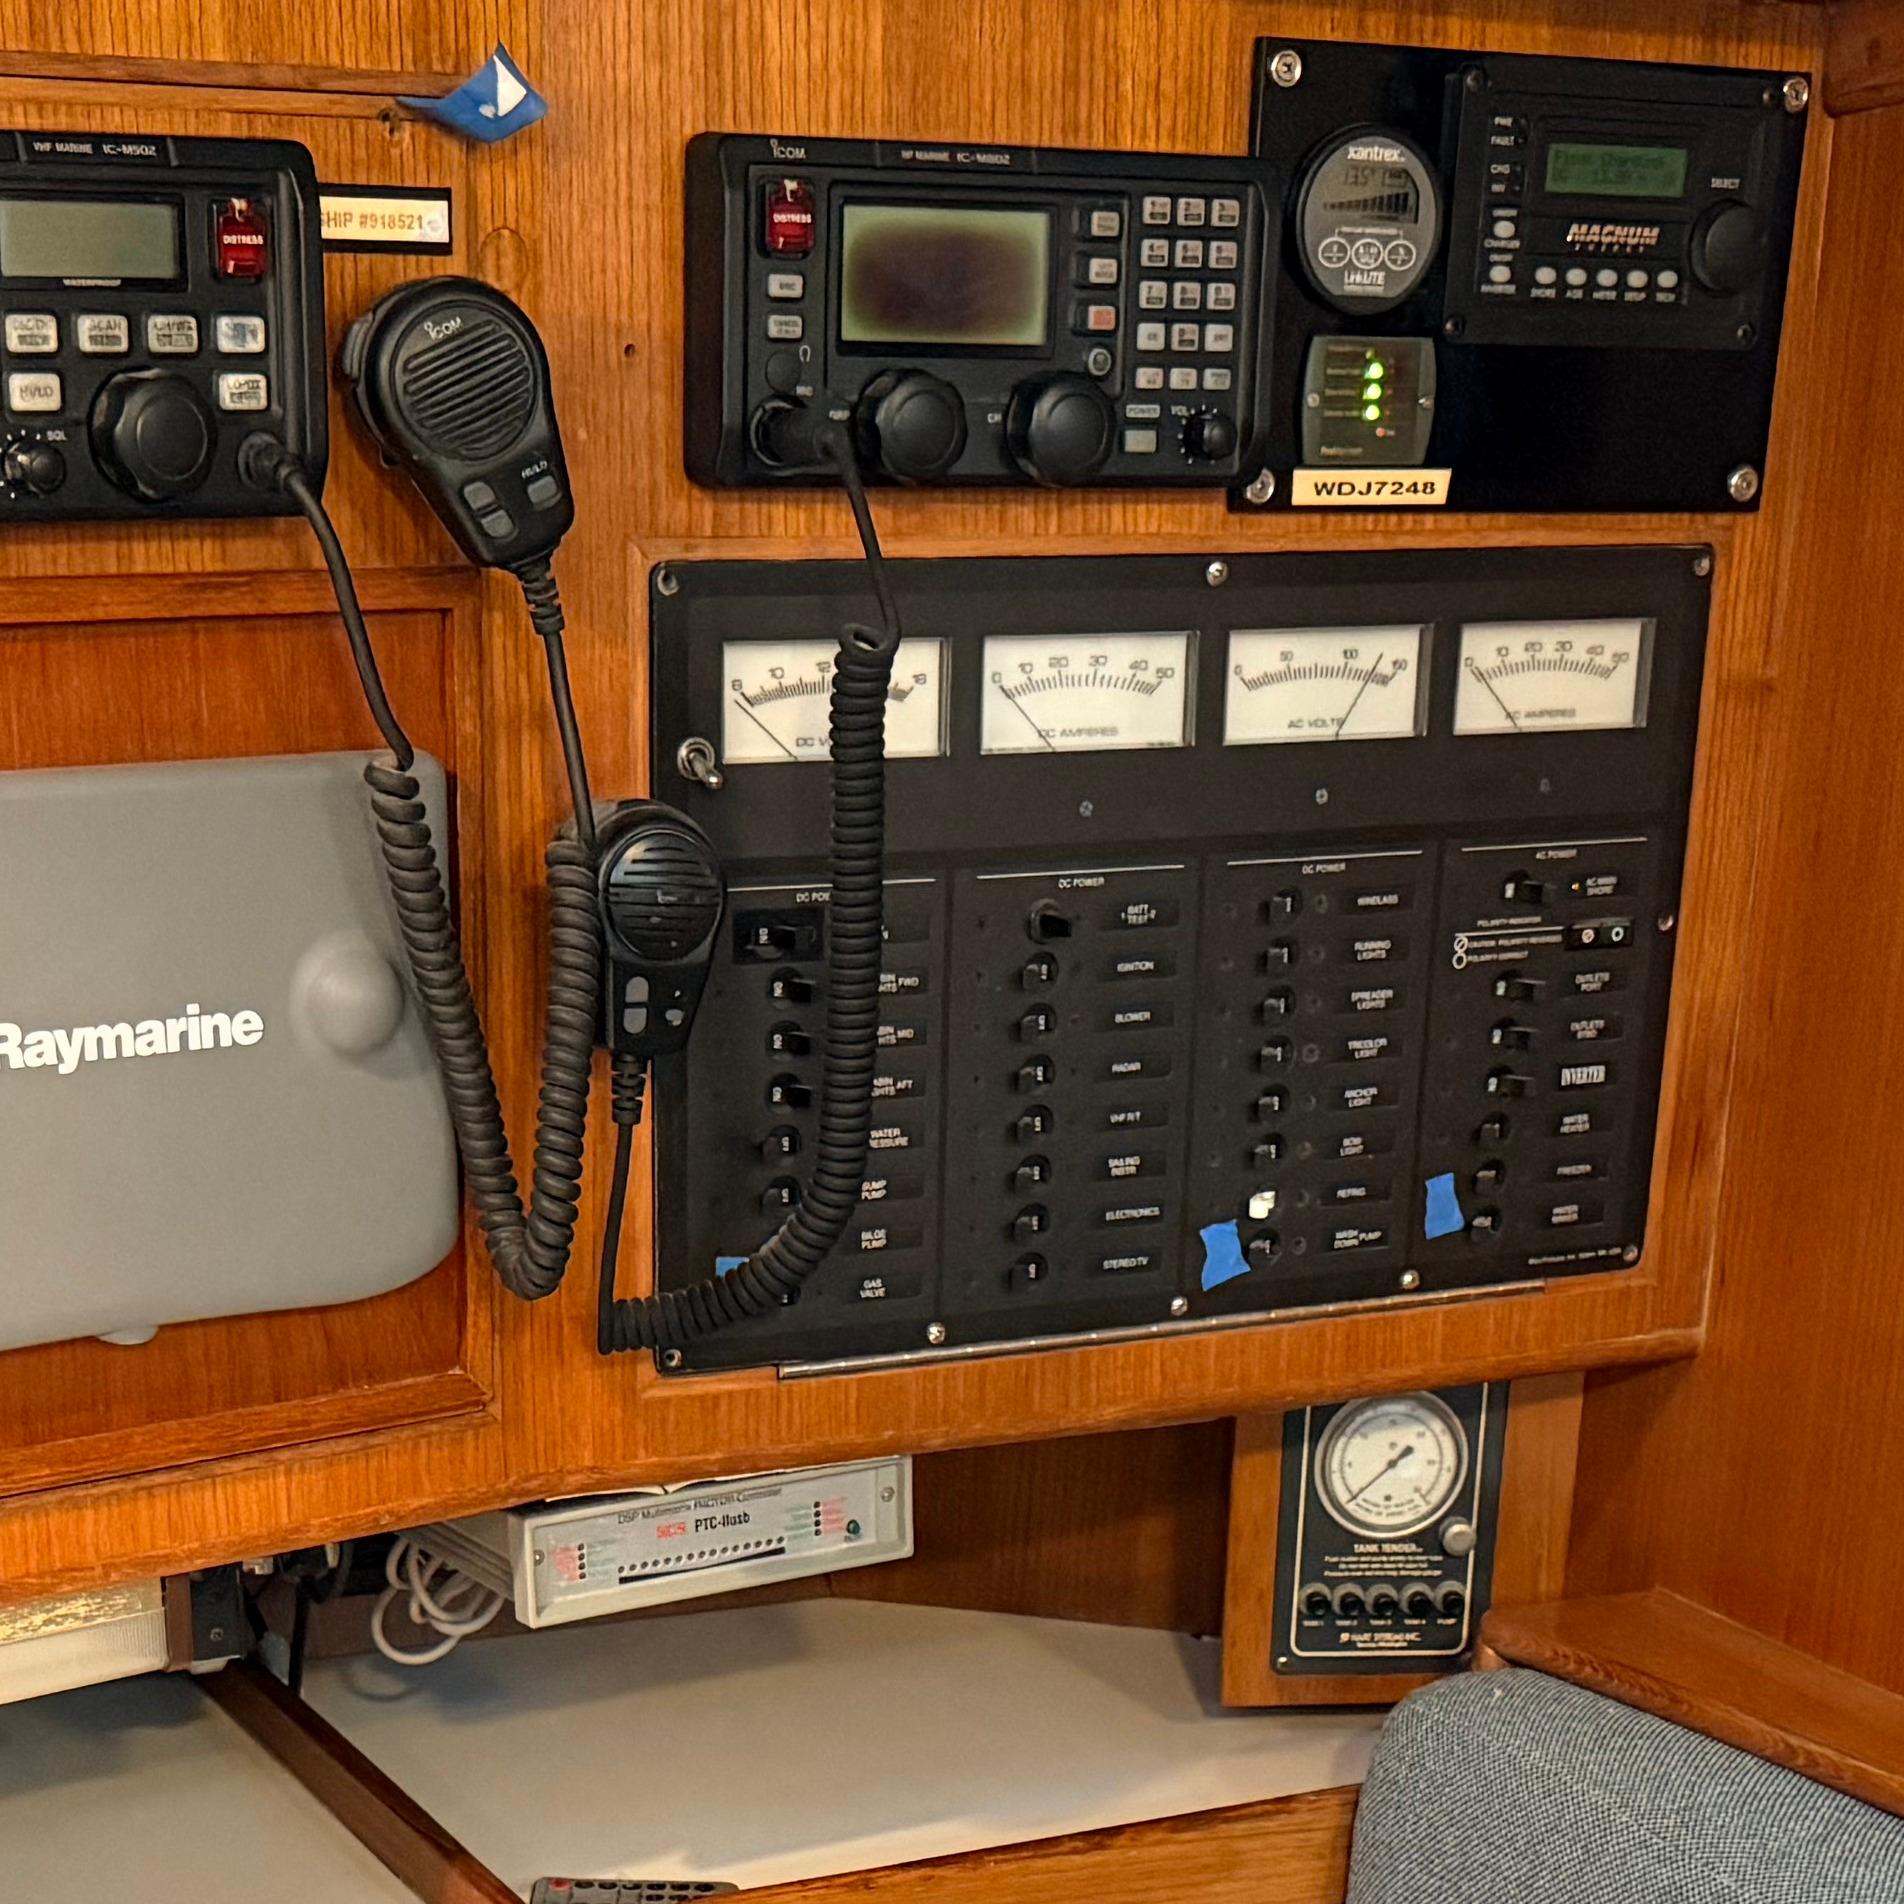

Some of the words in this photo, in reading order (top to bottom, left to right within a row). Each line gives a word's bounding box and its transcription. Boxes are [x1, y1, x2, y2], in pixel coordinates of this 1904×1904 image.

[1566, 223, 1660, 246] MAGNUM
[1314, 481, 1435, 496] WDJ7248
[1554, 641, 1573, 652] 30
[1048, 656, 1069, 668] 20
[1089, 655, 1107, 667] 30
[1280, 651, 1293, 662] 50
[816, 660, 831, 673] 12
[1019, 662, 1033, 674] 10
[1129, 659, 1148, 671] 40
[768, 666, 785, 679] 10
[1156, 667, 1175, 679] 50
[1524, 708, 1576, 719] AMPERES
[1288, 719, 1305, 729] AC
[1060, 726, 1119, 738] AMPERES
[796, 736, 814, 747] DC
[1073, 876, 1105, 887] POWER
[1561, 1065, 1606, 1087] INVERTER
